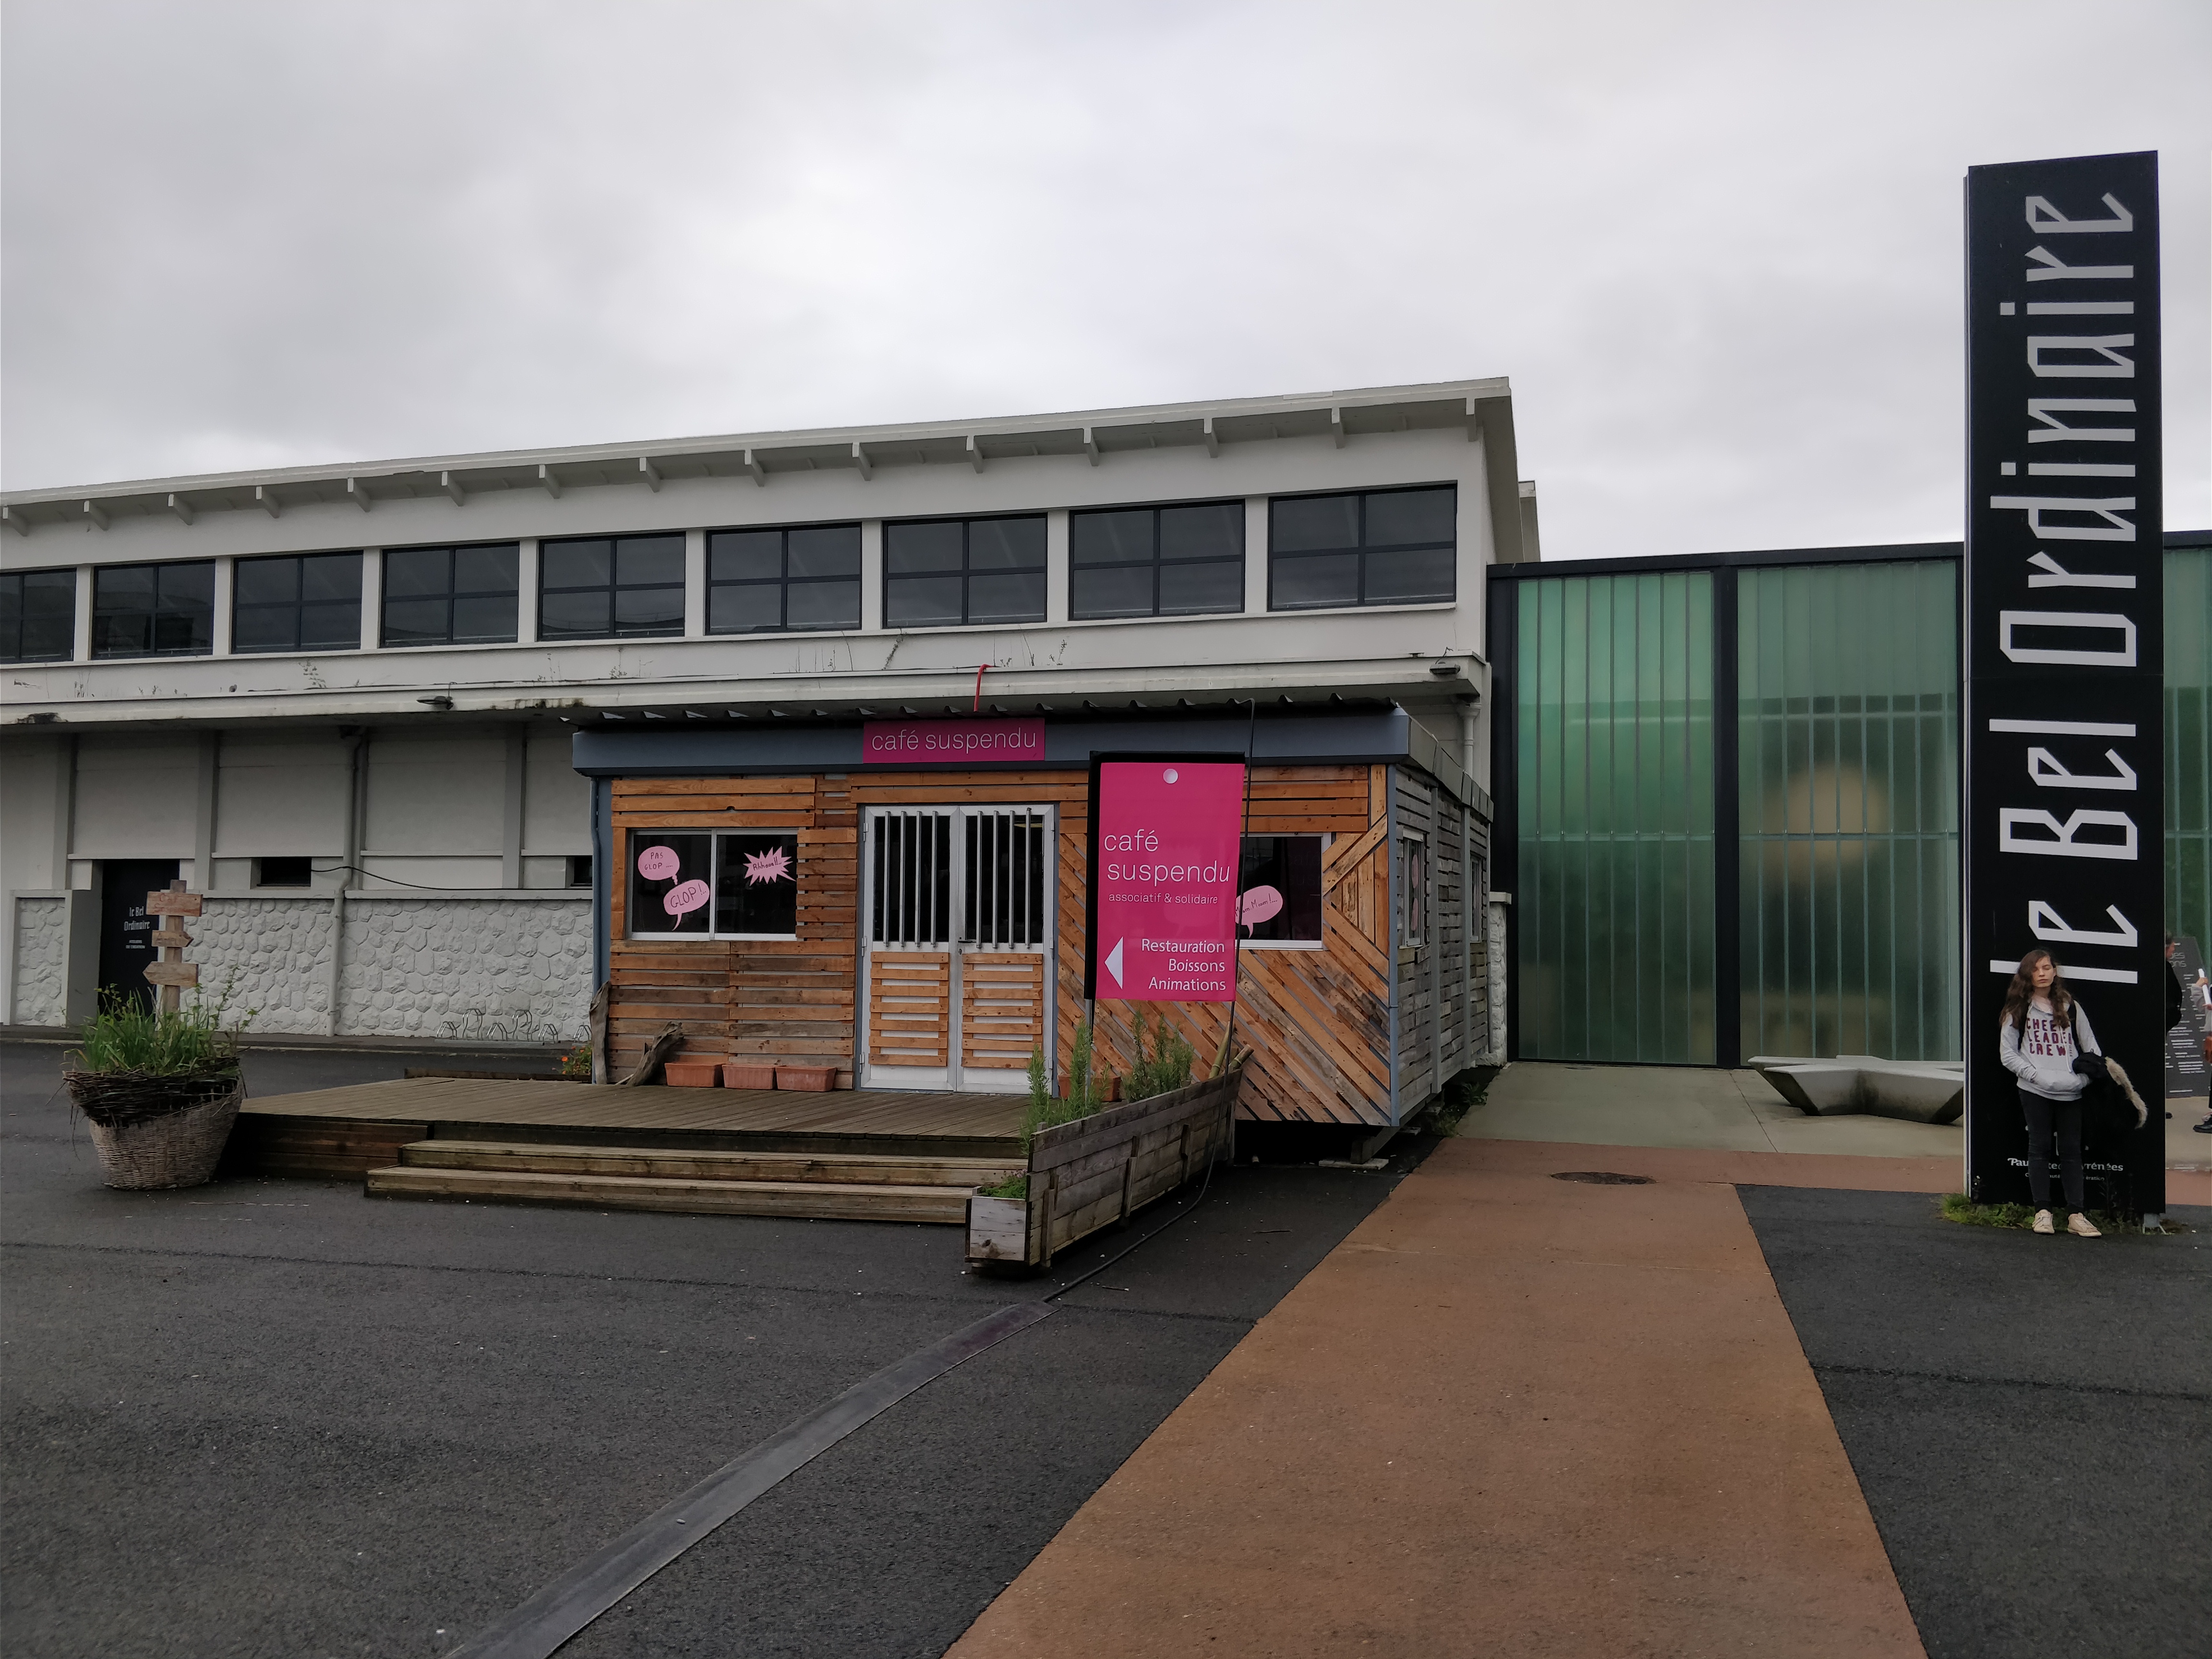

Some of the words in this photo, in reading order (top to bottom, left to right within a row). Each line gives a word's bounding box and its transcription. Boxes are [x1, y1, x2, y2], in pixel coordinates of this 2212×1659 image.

[1990, 192, 2137, 667] Ordinaire
[872, 729, 919, 750] café
[925, 727, 1036, 754] suspendu
[1989, 719, 2138, 860] Bel
[1104, 829, 1159, 852] café
[1107, 860, 1230, 887] suspendu
[1109, 893, 1161, 903] associatif
[1164, 893, 1172, 903] &
[1175, 894, 1218, 904] solidaire
[1142, 938, 1225, 953] Restauration
[1990, 900, 2138, 984] le
[1168, 958, 1225, 972] Boissons
[1148, 976, 1226, 991] Animations
[2027, 1018, 2066, 1032] CHEE
[2030, 1043, 2066, 1056] CREW
